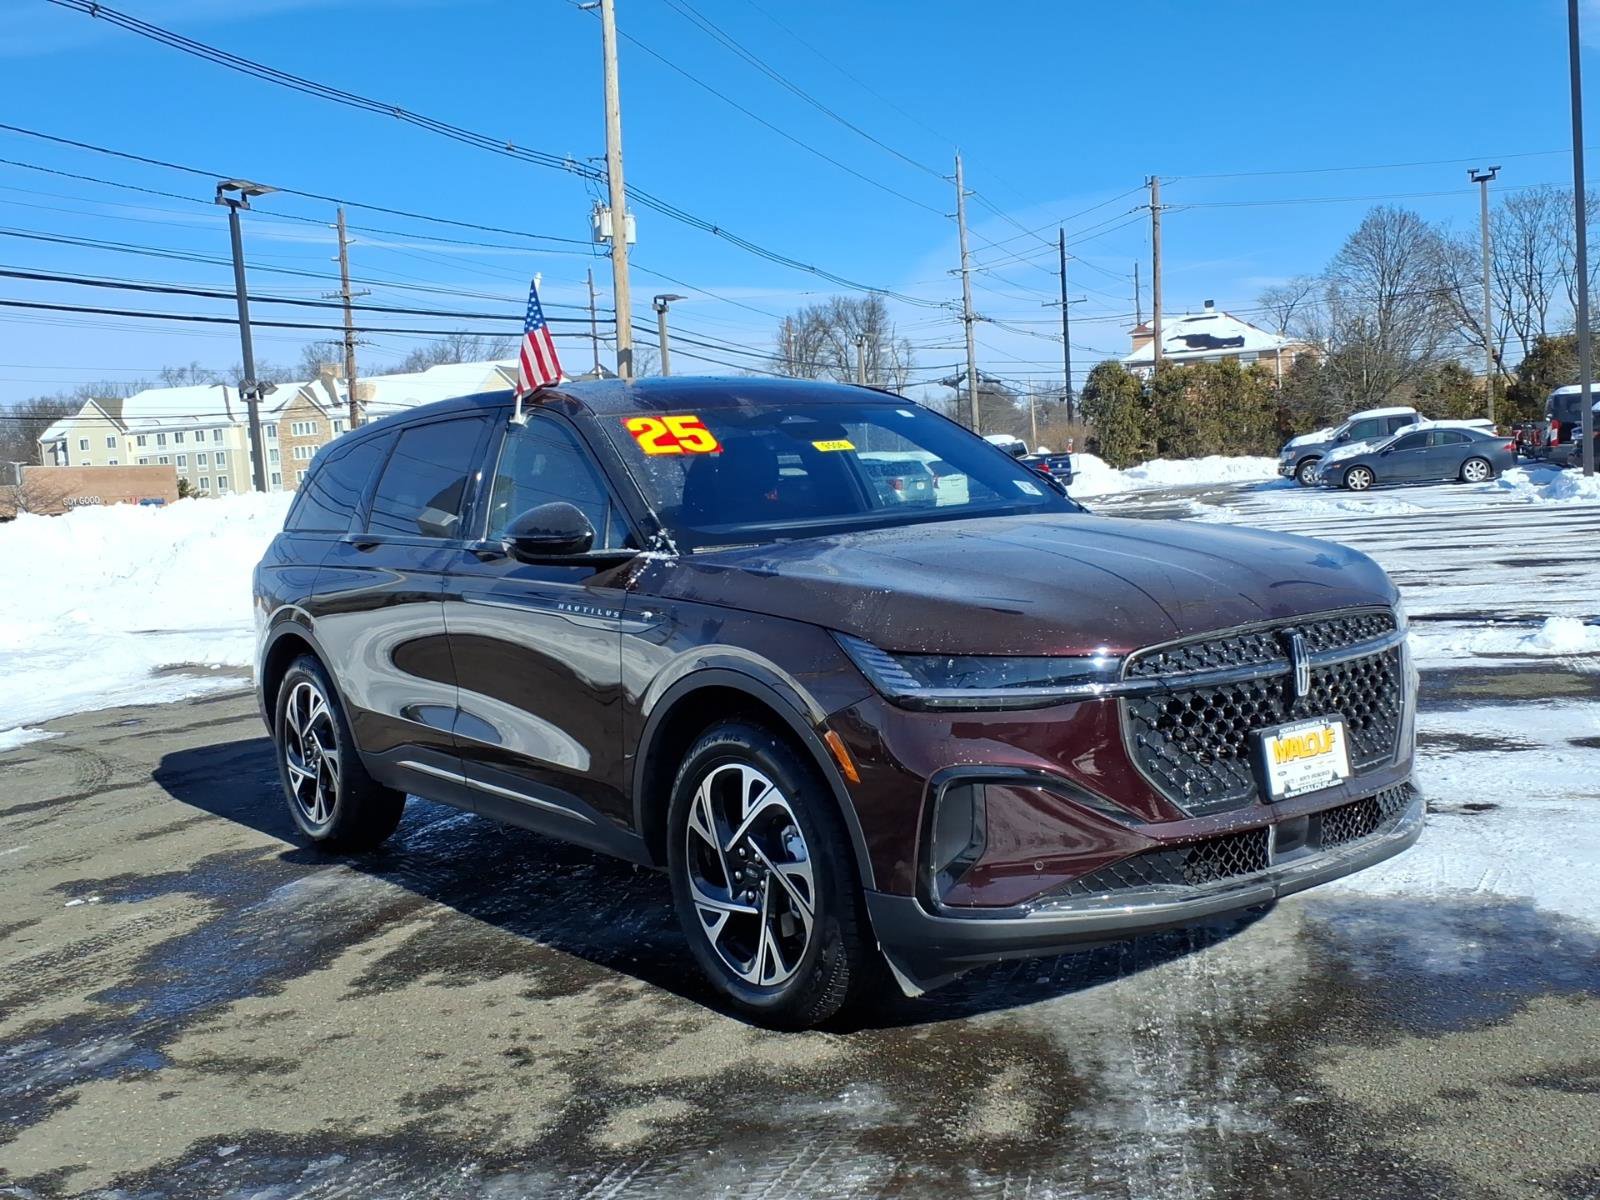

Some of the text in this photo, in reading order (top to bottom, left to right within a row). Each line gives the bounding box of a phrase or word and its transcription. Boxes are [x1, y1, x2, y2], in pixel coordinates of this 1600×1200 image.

[626, 415, 718, 454] 25
[79, 495, 100, 504] GOOD
[558, 603, 619, 618] NAUTILUS
[1272, 727, 1336, 765] MALOUF
